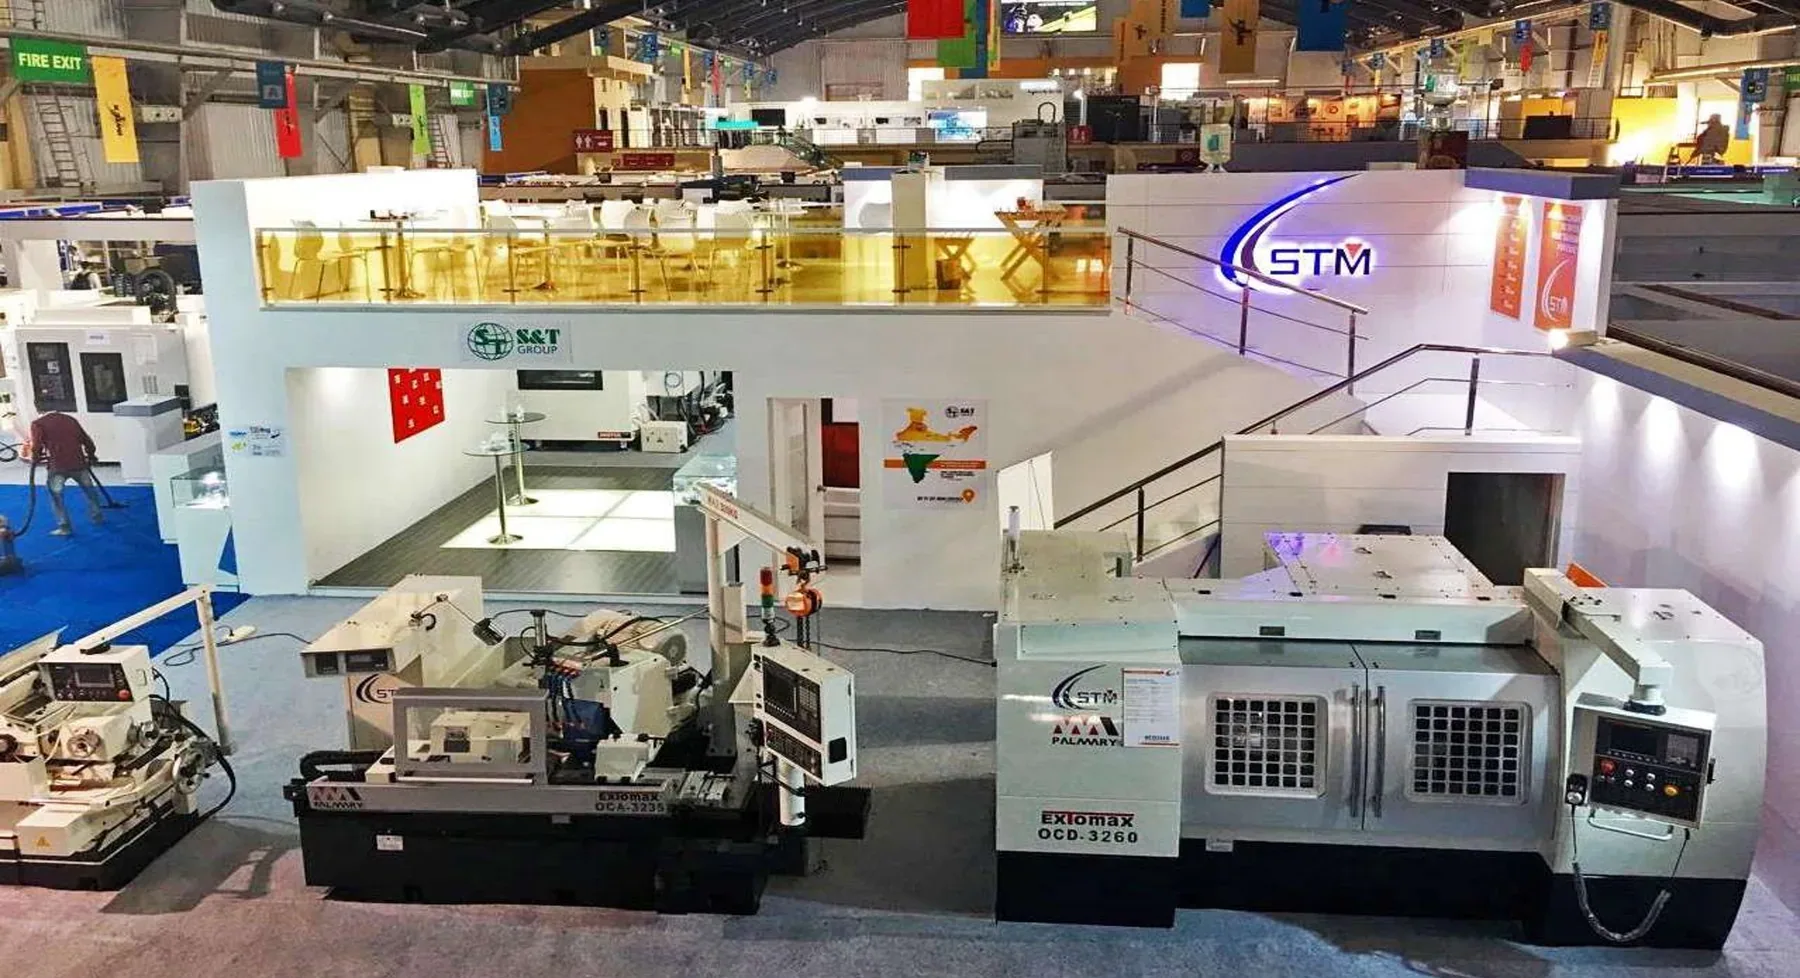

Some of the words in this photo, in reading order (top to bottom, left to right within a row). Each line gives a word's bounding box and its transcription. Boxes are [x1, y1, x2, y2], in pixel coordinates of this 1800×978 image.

[18, 53, 50, 68] FIRE
[53, 56, 81, 70] EXIT
[1270, 245, 1371, 275] STM
[516, 329, 560, 344] S&T
[517, 345, 558, 354] GROUP
[1077, 690, 1118, 704] STM
[1052, 736, 1117, 746] PALMARY
